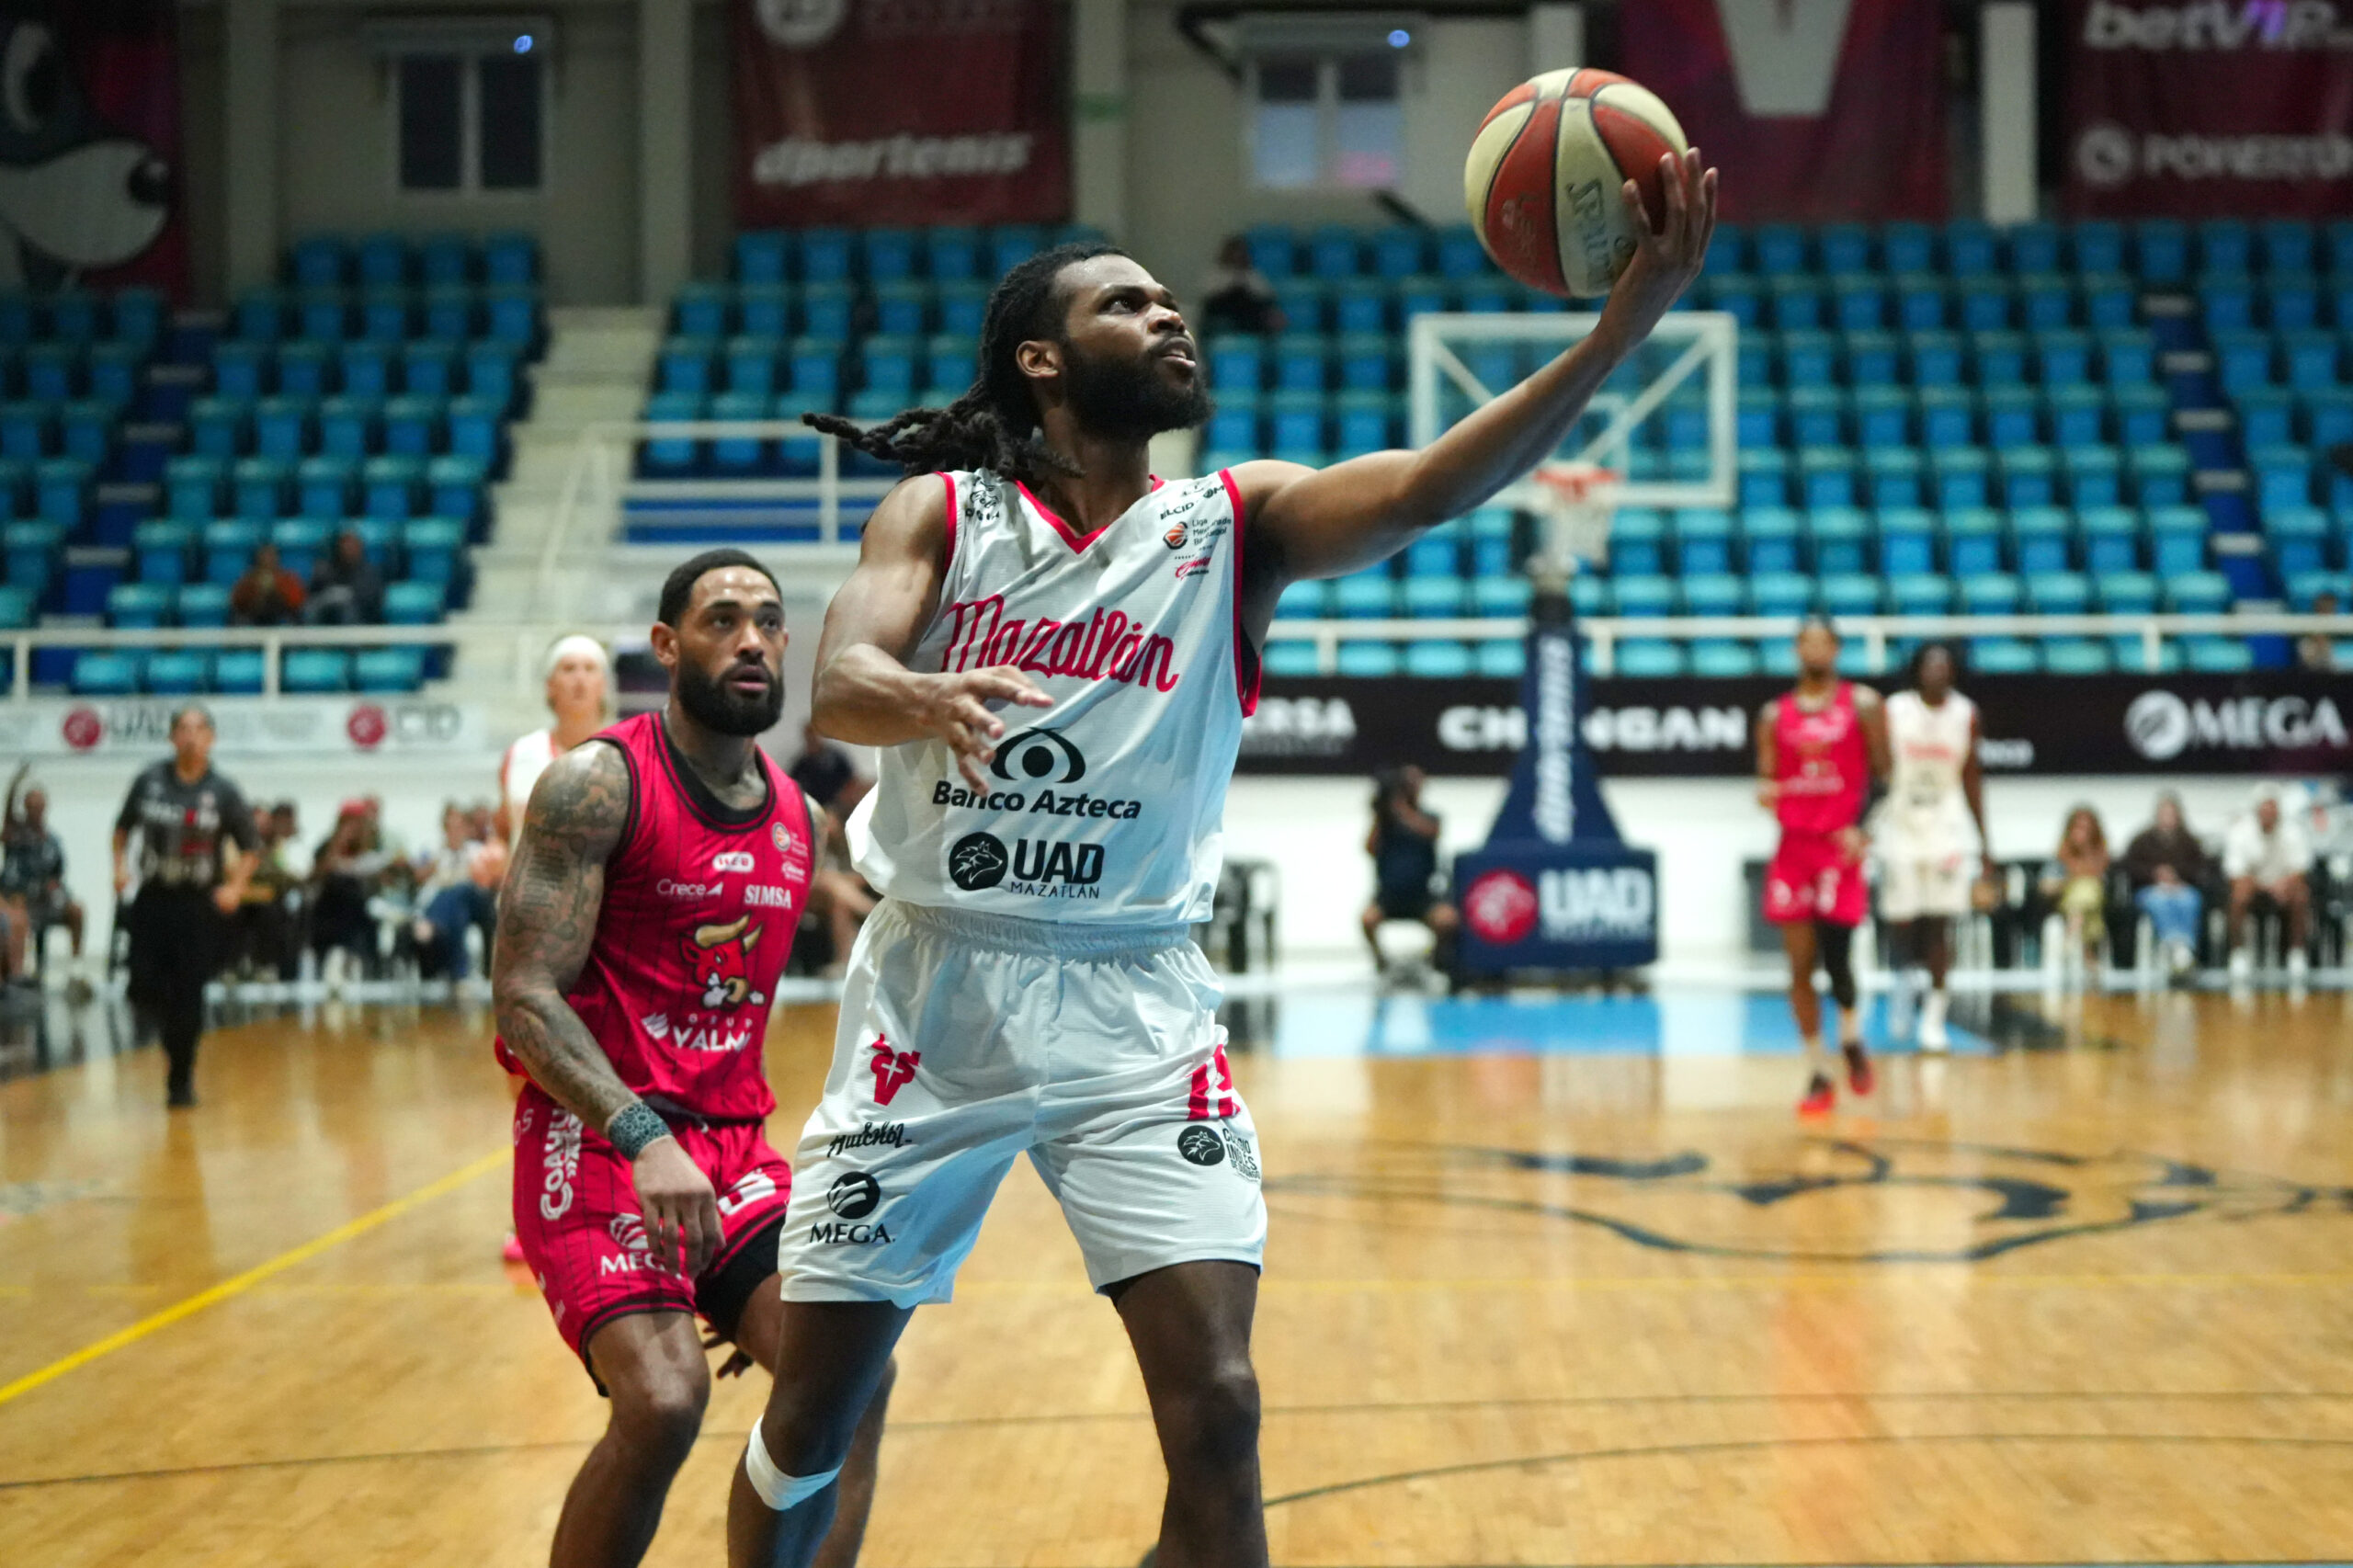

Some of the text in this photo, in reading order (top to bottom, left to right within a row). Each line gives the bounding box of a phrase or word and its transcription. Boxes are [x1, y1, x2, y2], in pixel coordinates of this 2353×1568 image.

[940, 594, 1179, 693] Mazatlán
[1438, 705, 1746, 751] CHNGAN
[2192, 697, 2349, 748] MEGA
[932, 780, 1142, 819] Banco Azteca
[1013, 838, 1105, 884] UAD
[656, 878, 707, 896] Crece
[745, 884, 791, 909] SIMSA
[1010, 880, 1099, 899] MAZATLÁN
